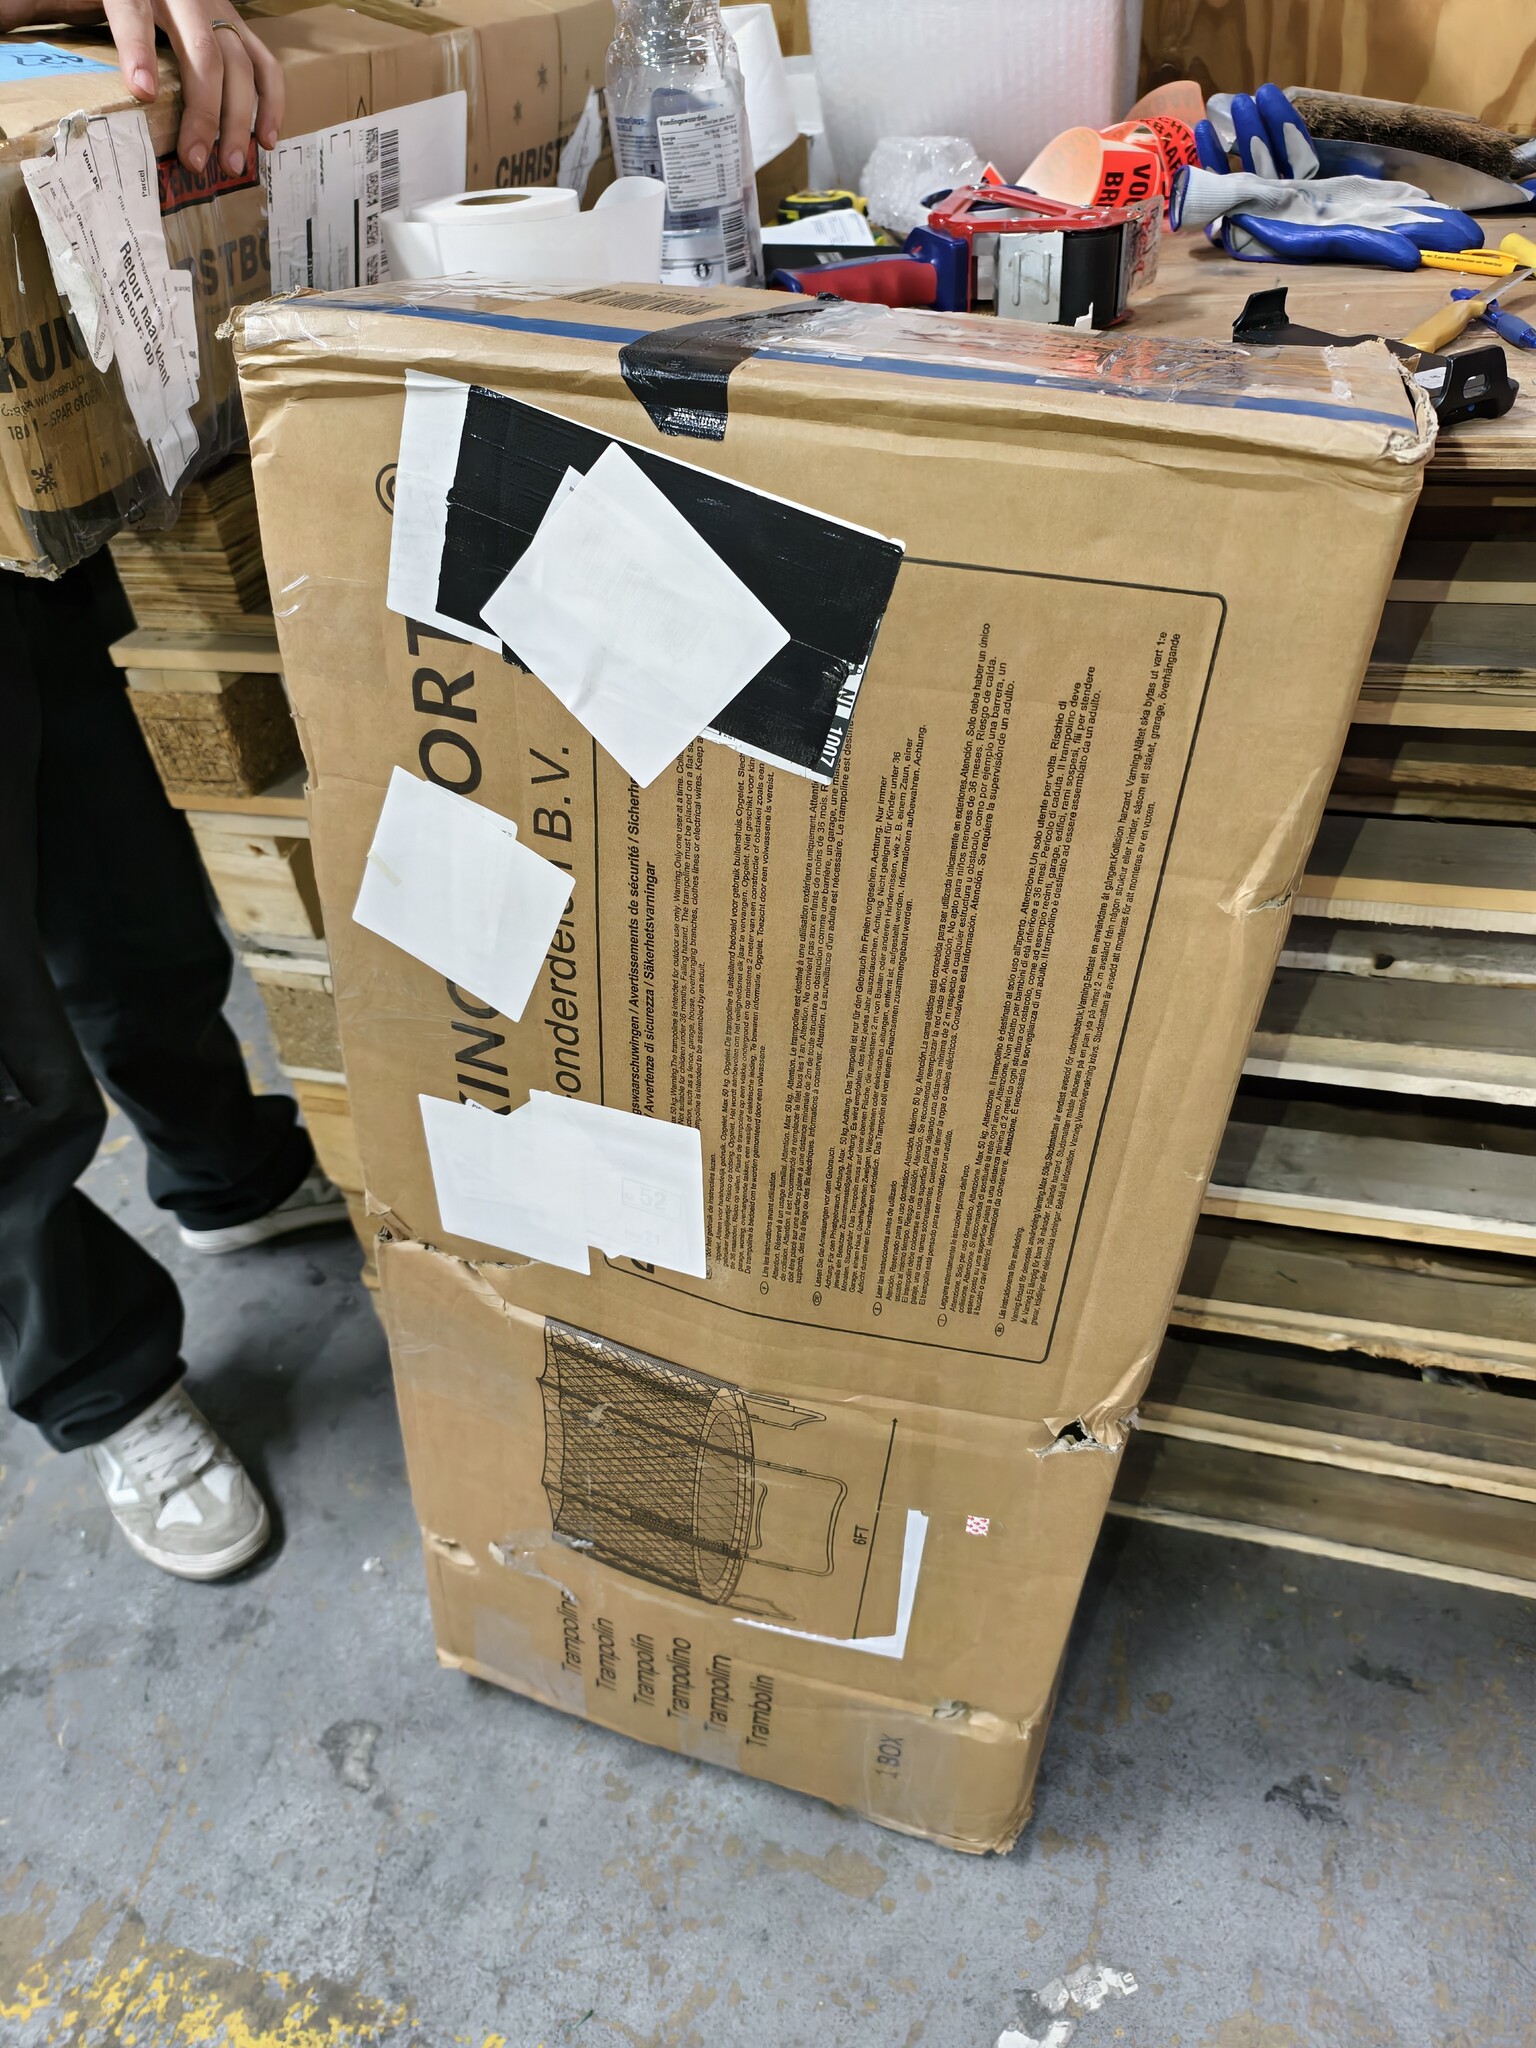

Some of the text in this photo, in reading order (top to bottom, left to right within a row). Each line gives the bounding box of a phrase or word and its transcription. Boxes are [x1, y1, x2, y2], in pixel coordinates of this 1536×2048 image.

[138, 169, 148, 198] Parcel
[119, 241, 144, 303] Retour
[118, 279, 144, 340] Retour:
[143, 341, 155, 366] DD
[529, 746, 573, 842] B.V.
[675, 775, 684, 796] time.
[676, 796, 683, 804] a
[626, 772, 643, 835] Sicherhe
[675, 804, 683, 814] at
[675, 812, 683, 833] user
[626, 845, 639, 897] sécurité
[672, 848, 684, 902] Warning.Only
[626, 899, 639, 916] de
[642, 860, 658, 980] Säkerhetsvarningar
[902, 897, 913, 932] werden.
[627, 917, 639, 1008] Avertissements
[671, 937, 680, 967] outdoor
[892, 932, 909, 1004] zusammengebaut
[671, 966, 681, 979] for
[670, 978, 679, 1010] intended
[643, 988, 654, 1041] sicurezza
[670, 1009, 679, 1017] is
[670, 1017, 679, 1054] trampoline
[691, 961, 706, 1130] mpoline is intended to be assembled by an adult.
[884, 1004, 899, 1056] Erwachsenen
[643, 1041, 654, 1053] di
[628, 1015, 642, 1116] gswaarschuwingen
[882, 1055, 892, 1079] einem
[643, 1054, 654, 1113] Avvertenze
[879, 1092, 888, 1106] soll
[881, 1078, 890, 1093] von
[667, 1114, 678, 1124] ax
[669, 1105, 677, 1115] 50
[874, 1106, 886, 1140] Trampolin
[824, 1144, 836, 1180] Gebrauch.
[872, 1140, 882, 1155] Das
[823, 1179, 832, 1195] dem
[818, 1205, 830, 1248] Anweisungen
[863, 1193, 875, 1236] Erwachsenen
[817, 1247, 825, 1258] die
[862, 1235, 870, 1253] einen
[813, 1268, 823, 1288] Lesen
[815, 1257, 824, 1269] Sie
[859, 1253, 868, 1271] durch
[856, 1270, 866, 1294] Aufsicht
[852, 1524, 870, 1546] 6FT
[592, 1617, 621, 1692] Trampolin
[665, 1636, 695, 1719] Trampolino
[704, 1653, 735, 1734] Trampolim
[745, 1674, 775, 1748] Trambolin
[877, 1733, 904, 1766] BOX
